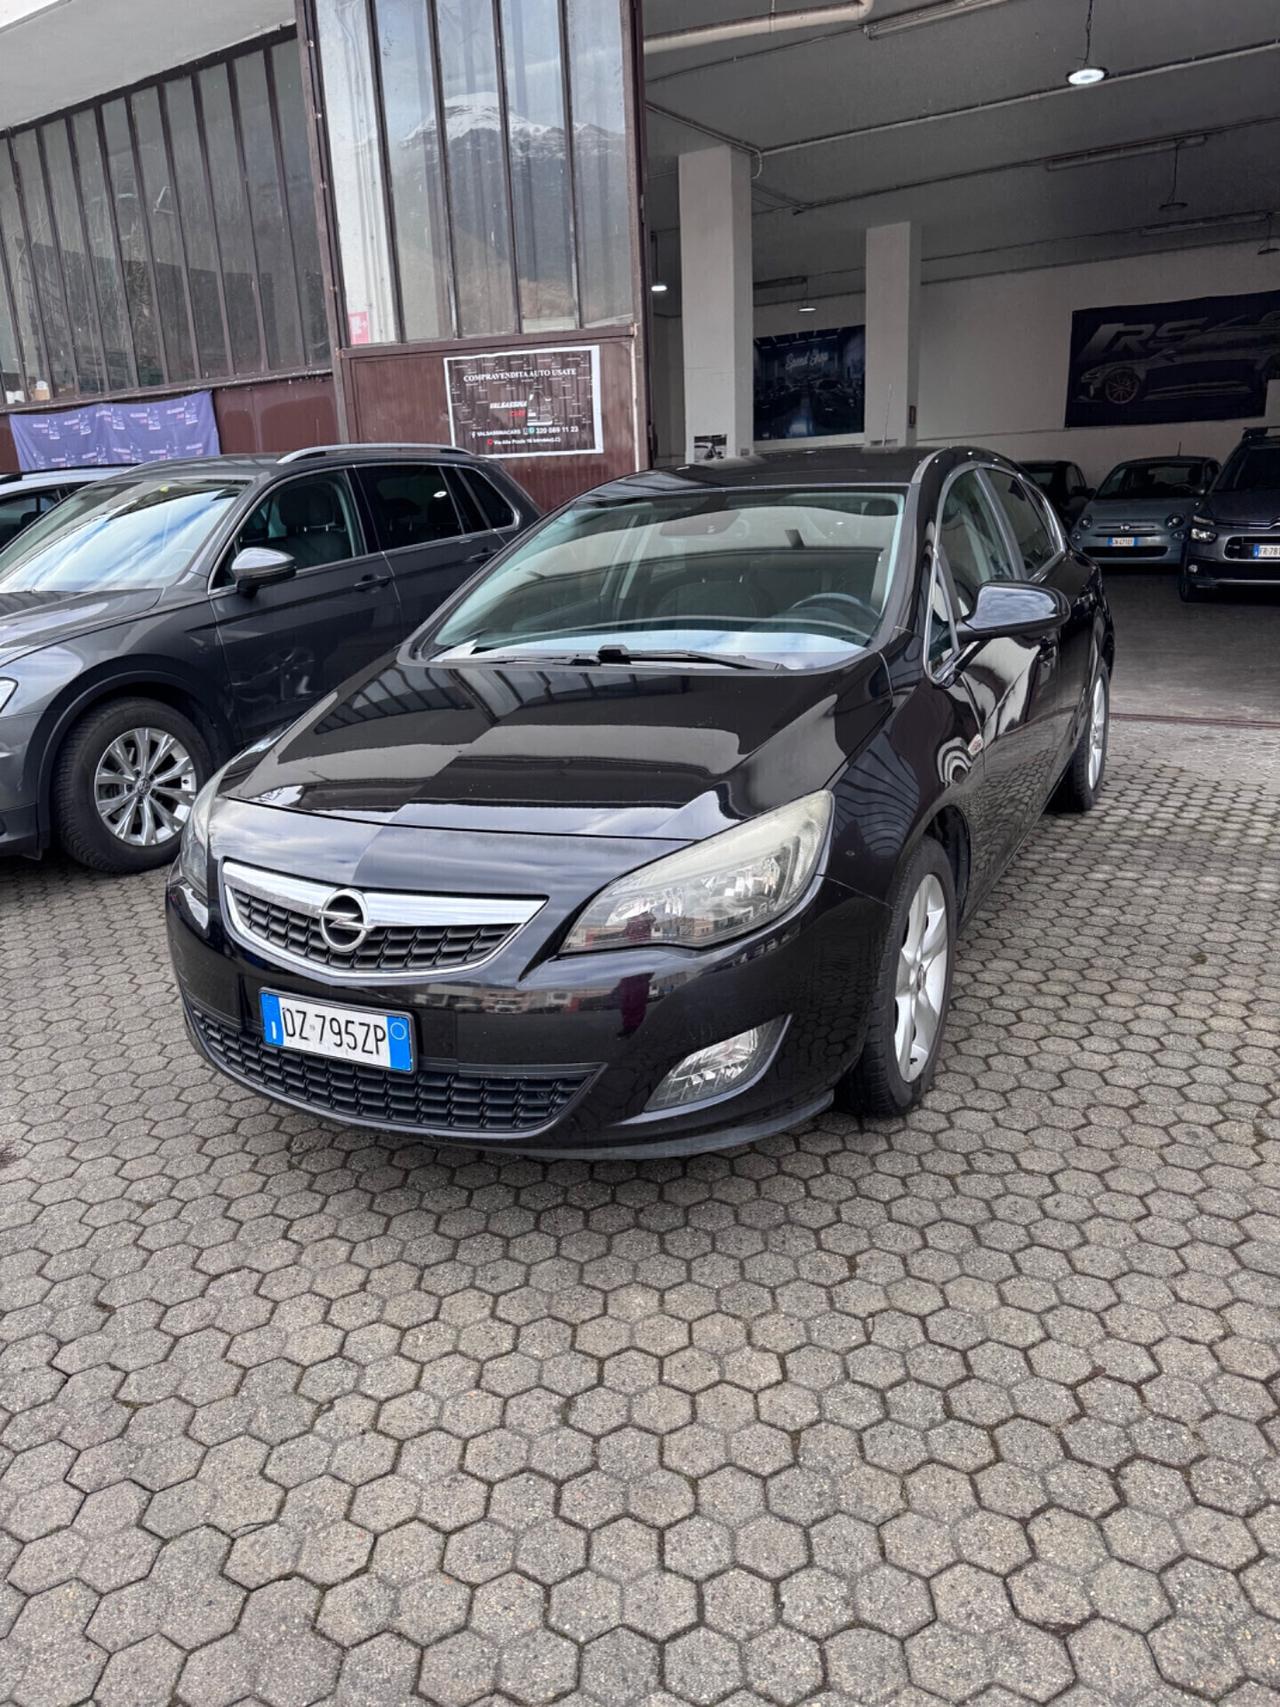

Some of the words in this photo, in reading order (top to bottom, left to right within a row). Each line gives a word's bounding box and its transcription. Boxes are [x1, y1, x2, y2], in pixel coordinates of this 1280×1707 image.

[463, 371, 529, 383] COMPRAVENDITA
[529, 369, 551, 378] AUTO
[551, 368, 577, 377] USATE
[570, 425, 579, 433] 23
